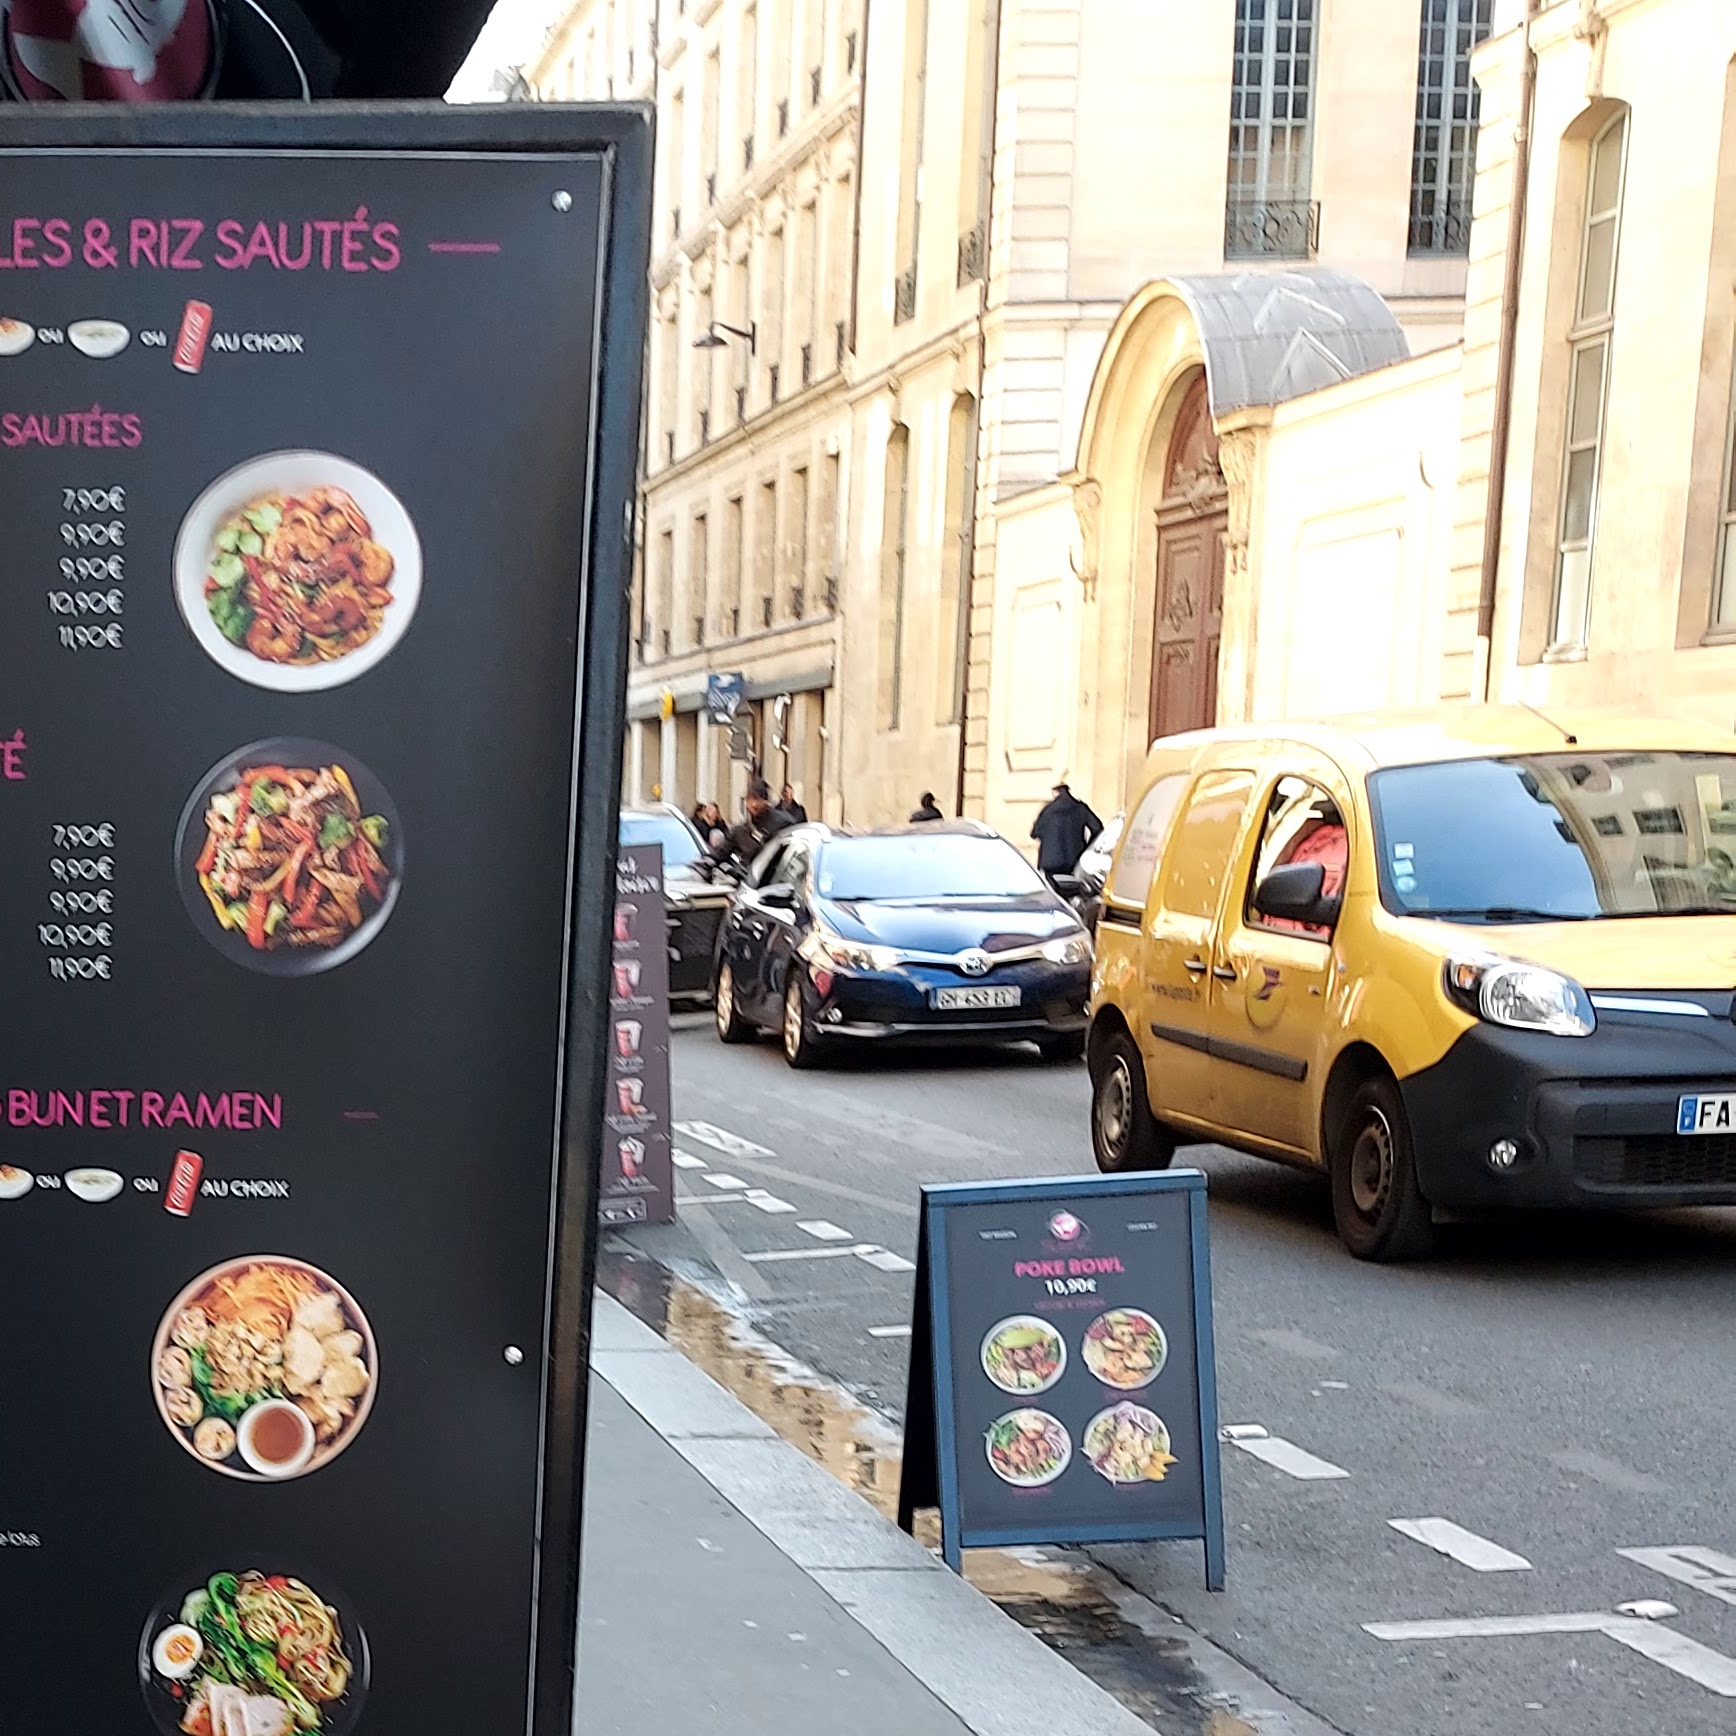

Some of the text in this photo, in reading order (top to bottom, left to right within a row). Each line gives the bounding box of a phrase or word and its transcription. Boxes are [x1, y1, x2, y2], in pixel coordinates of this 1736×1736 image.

[82, 219, 118, 270] &
[129, 219, 205, 269] RIZ
[215, 206, 401, 272] SAUTÉS
[211, 332, 240, 353] AU
[242, 333, 304, 354] CHOIX
[2, 403, 142, 449] SAUTÉES
[62, 485, 125, 515] 7,90€
[60, 520, 125, 549] 9,90€
[59, 554, 125, 583] 9,90€
[47, 588, 124, 617] 10,90€
[58, 622, 123, 651] 11,90€
[52, 822, 115, 850] 7,90€
[50, 855, 115, 884] 9,90€
[49, 888, 114, 917] 9,90€
[37, 921, 113, 949] 10,90€
[48, 954, 113, 982] 11,90€
[7, 1089, 84, 1129] BUN
[89, 1090, 137, 1128] ET
[140, 1090, 282, 1131] RAMEN
[201, 1179, 228, 1198] AU
[230, 1180, 290, 1200] CHOIX
[1014, 1256, 1126, 1278] POKE BOWL
